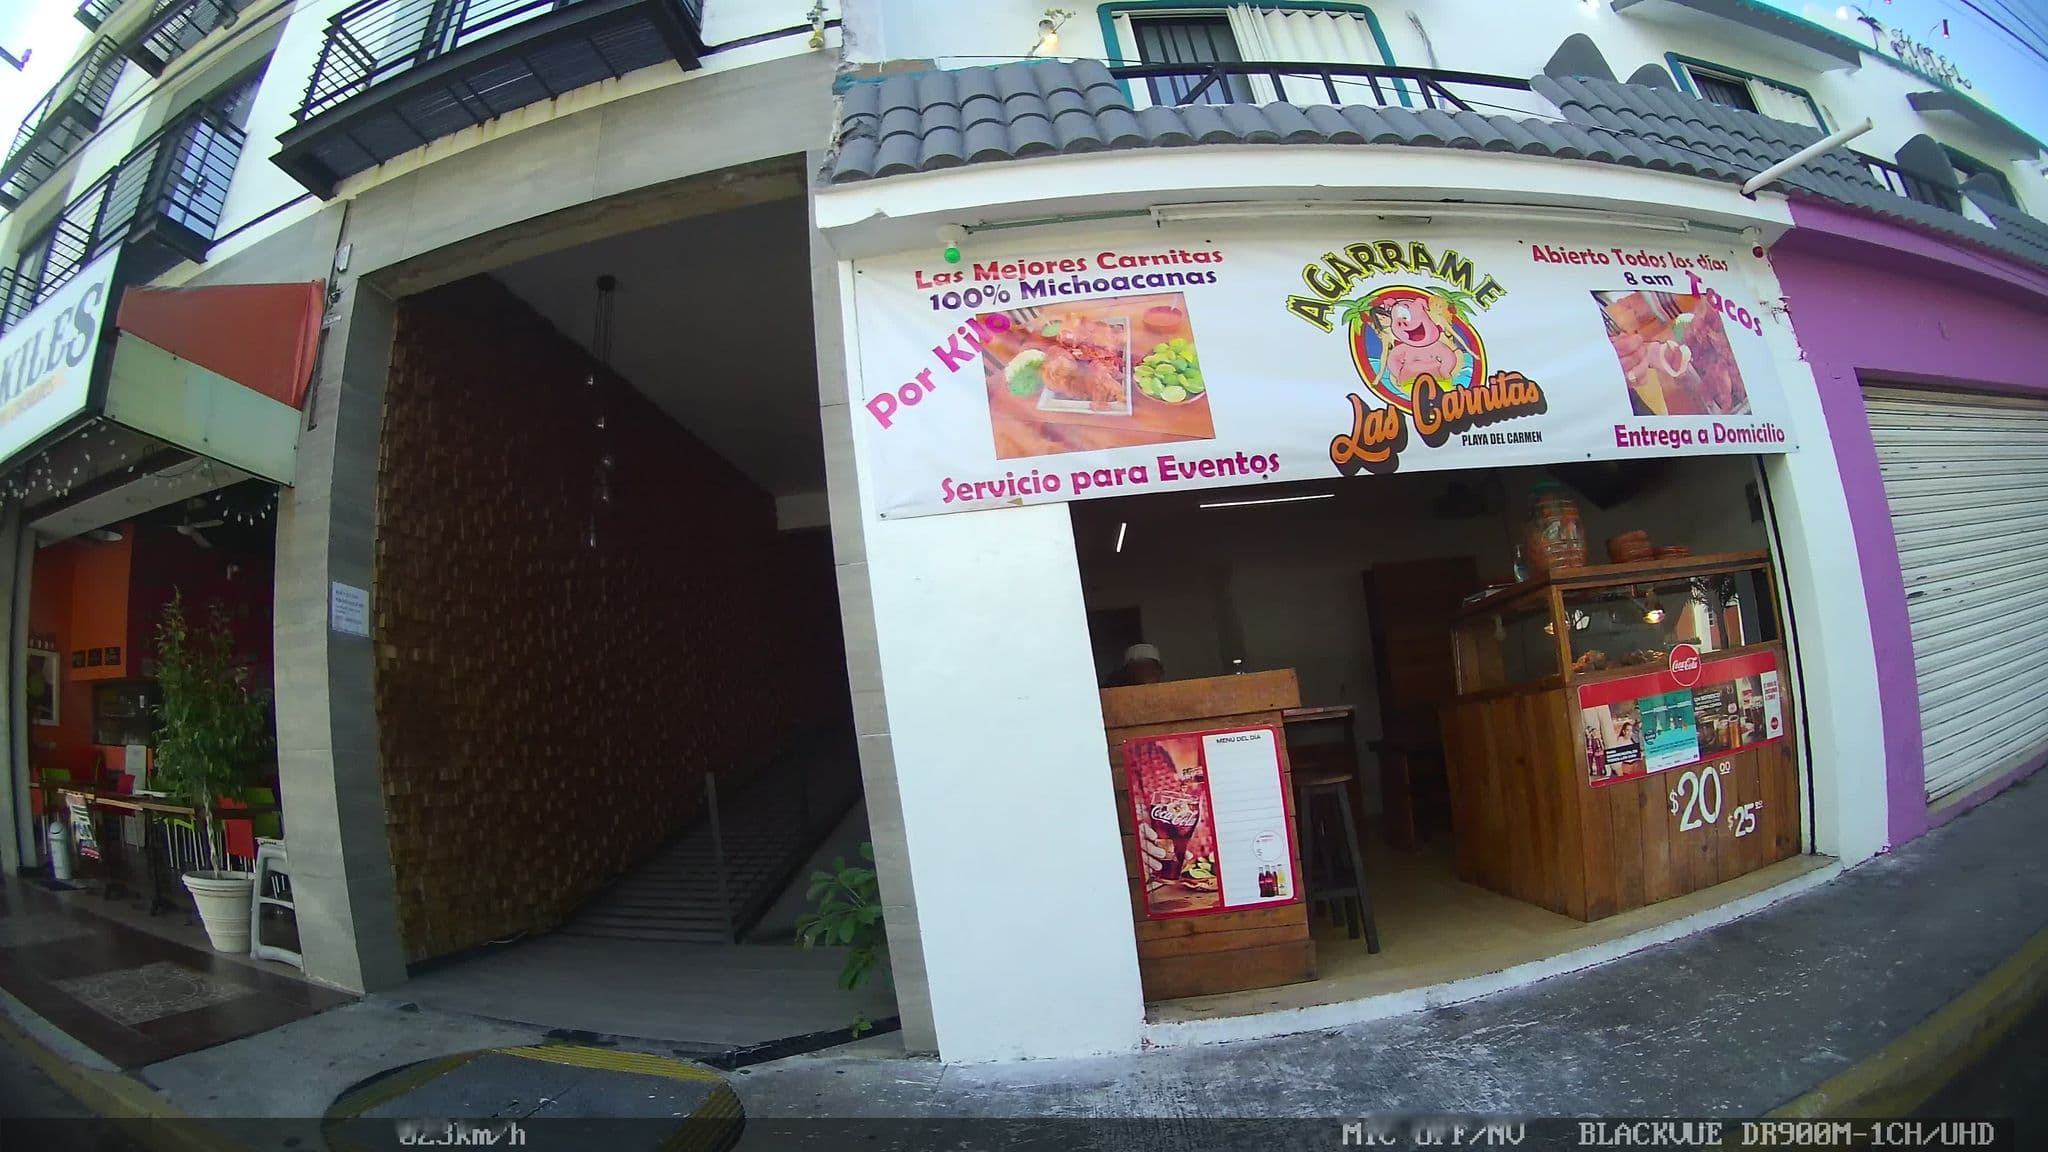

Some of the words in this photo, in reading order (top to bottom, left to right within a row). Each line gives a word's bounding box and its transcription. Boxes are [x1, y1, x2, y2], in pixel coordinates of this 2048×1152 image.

[914, 270, 964, 290] Las
[973, 258, 1088, 282] Mejores
[1096, 248, 1224, 270] Carnitas
[1532, 244, 1610, 265] Abierto
[1611, 248, 1667, 268] Todos
[1697, 254, 1728, 272] días
[1624, 272, 1637, 285] 8
[1641, 273, 1674, 286] am
[929, 284, 1011, 311] 100%
[1020, 268, 1217, 300] Michoacanas
[1286, 240, 1507, 333] AGARRAME
[1685, 270, 1763, 336] Tacos
[865, 366, 937, 429] Por
[932, 310, 1011, 373] Kilo
[1329, 393, 1406, 474] Las
[1410, 371, 1544, 441] Carnitas
[1461, 433, 1489, 447] PLAYA
[1490, 433, 1506, 445] DEL
[1506, 431, 1543, 444] CARMEN
[1614, 424, 1693, 449] Entrega
[1697, 429, 1709, 443] a
[1712, 422, 1785, 443] Domicilio
[941, 468, 1060, 504] Servicio
[1070, 461, 1149, 494] para
[1157, 450, 1281, 482] Eventos
